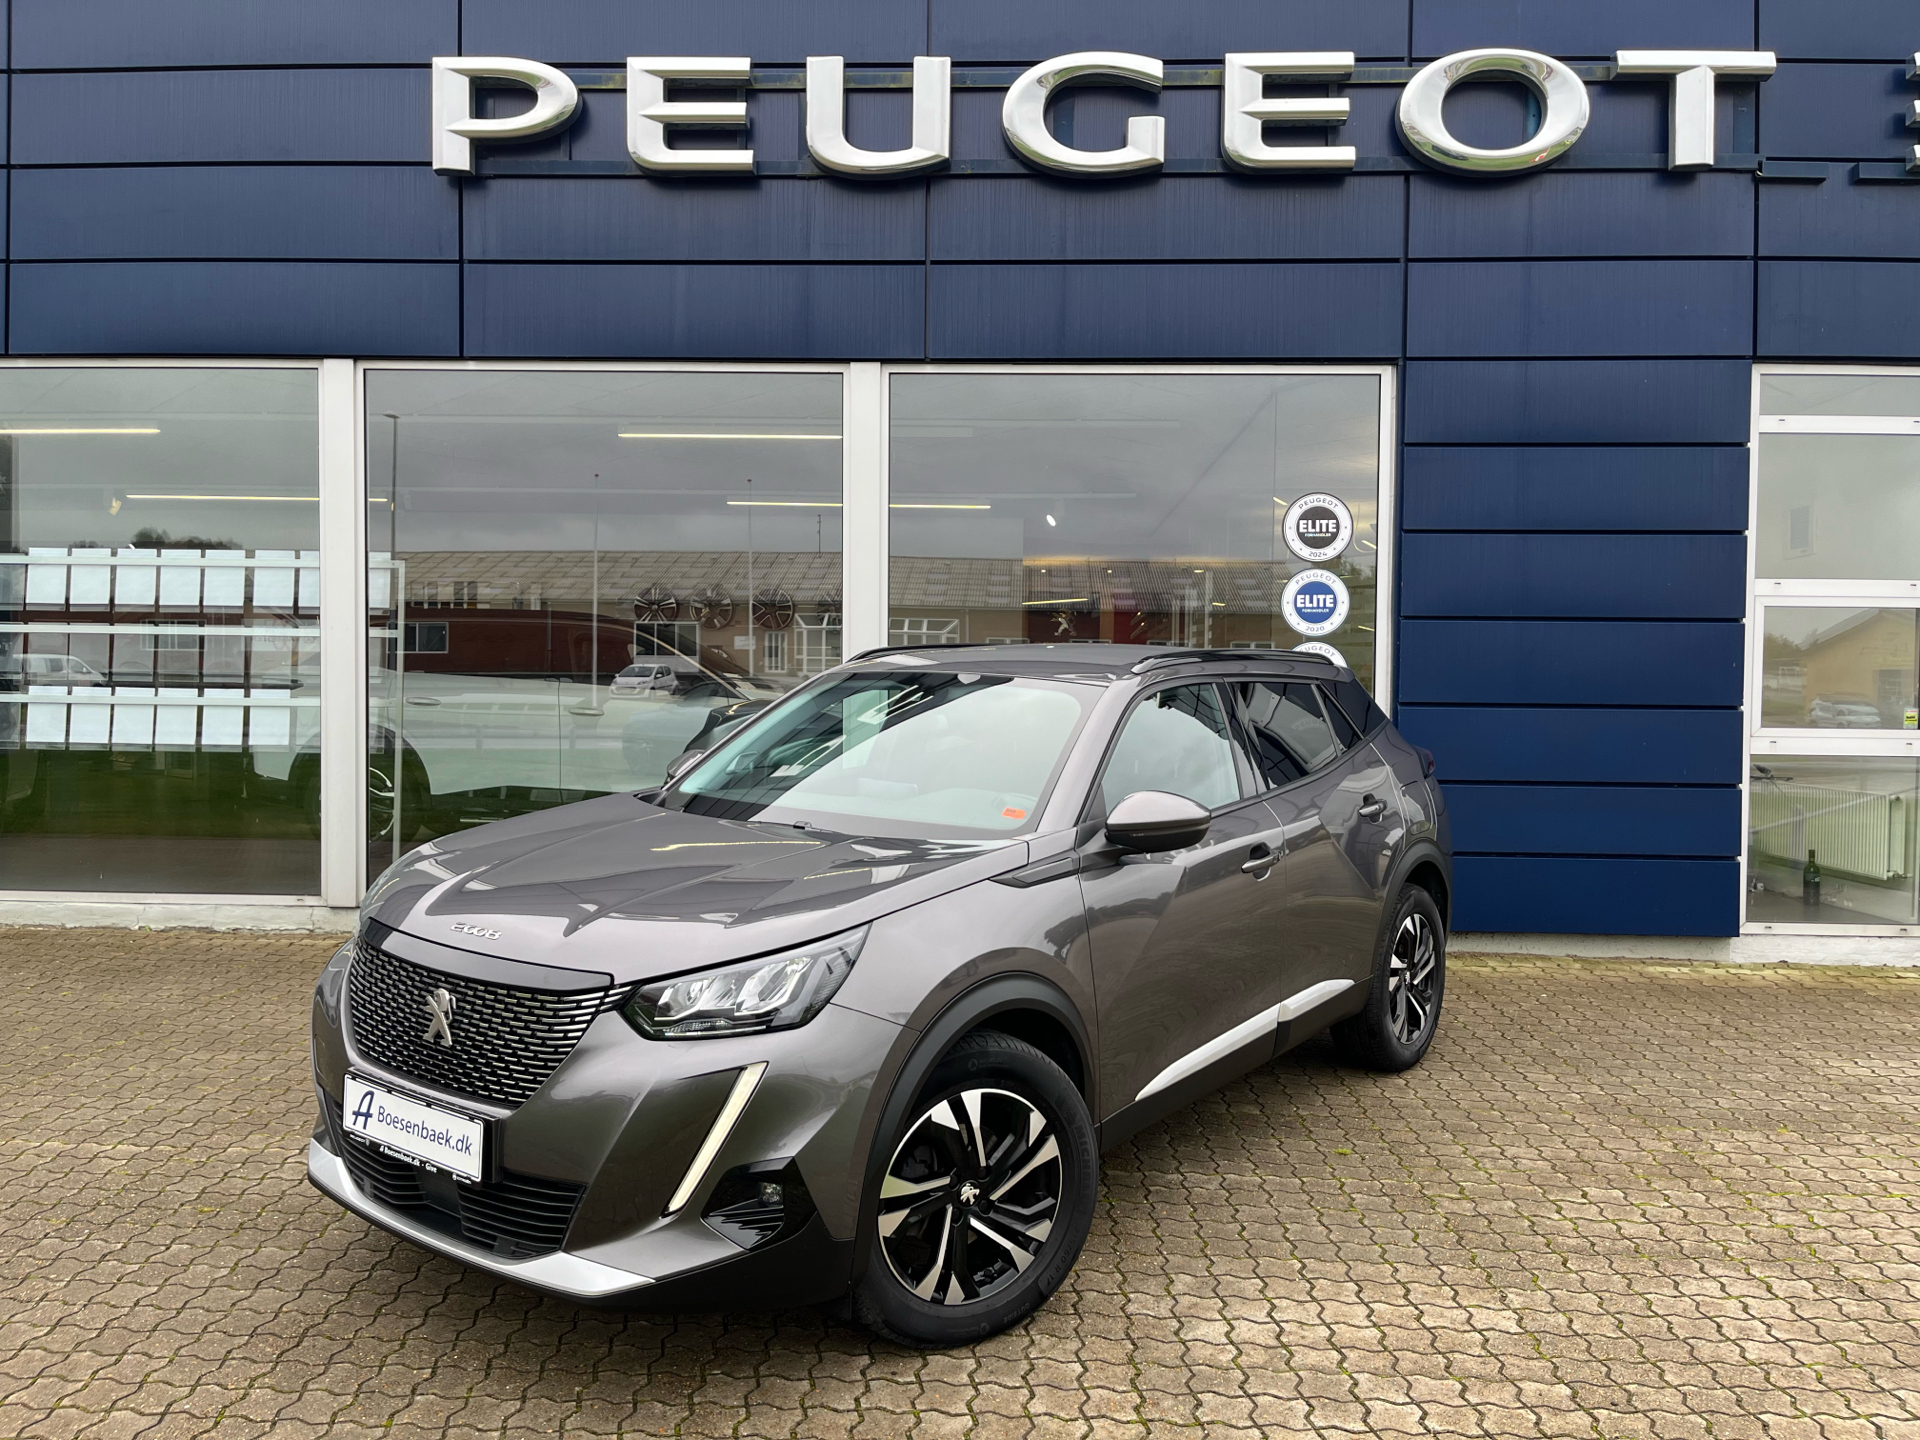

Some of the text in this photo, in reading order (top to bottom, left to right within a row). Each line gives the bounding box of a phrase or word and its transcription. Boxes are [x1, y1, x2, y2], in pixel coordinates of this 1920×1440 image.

[431, 47, 1777, 178] PEUGEOT
[1298, 497, 1338, 509] PEUGEOT
[1299, 519, 1337, 532] ELITE
[1295, 572, 1336, 585] PEUGEOT
[1296, 594, 1334, 608] ELITE
[1301, 645, 1336, 657] UGEOT
[450, 921, 502, 941] 2008
[352, 1090, 472, 1156] A Boesenbaek.dk
